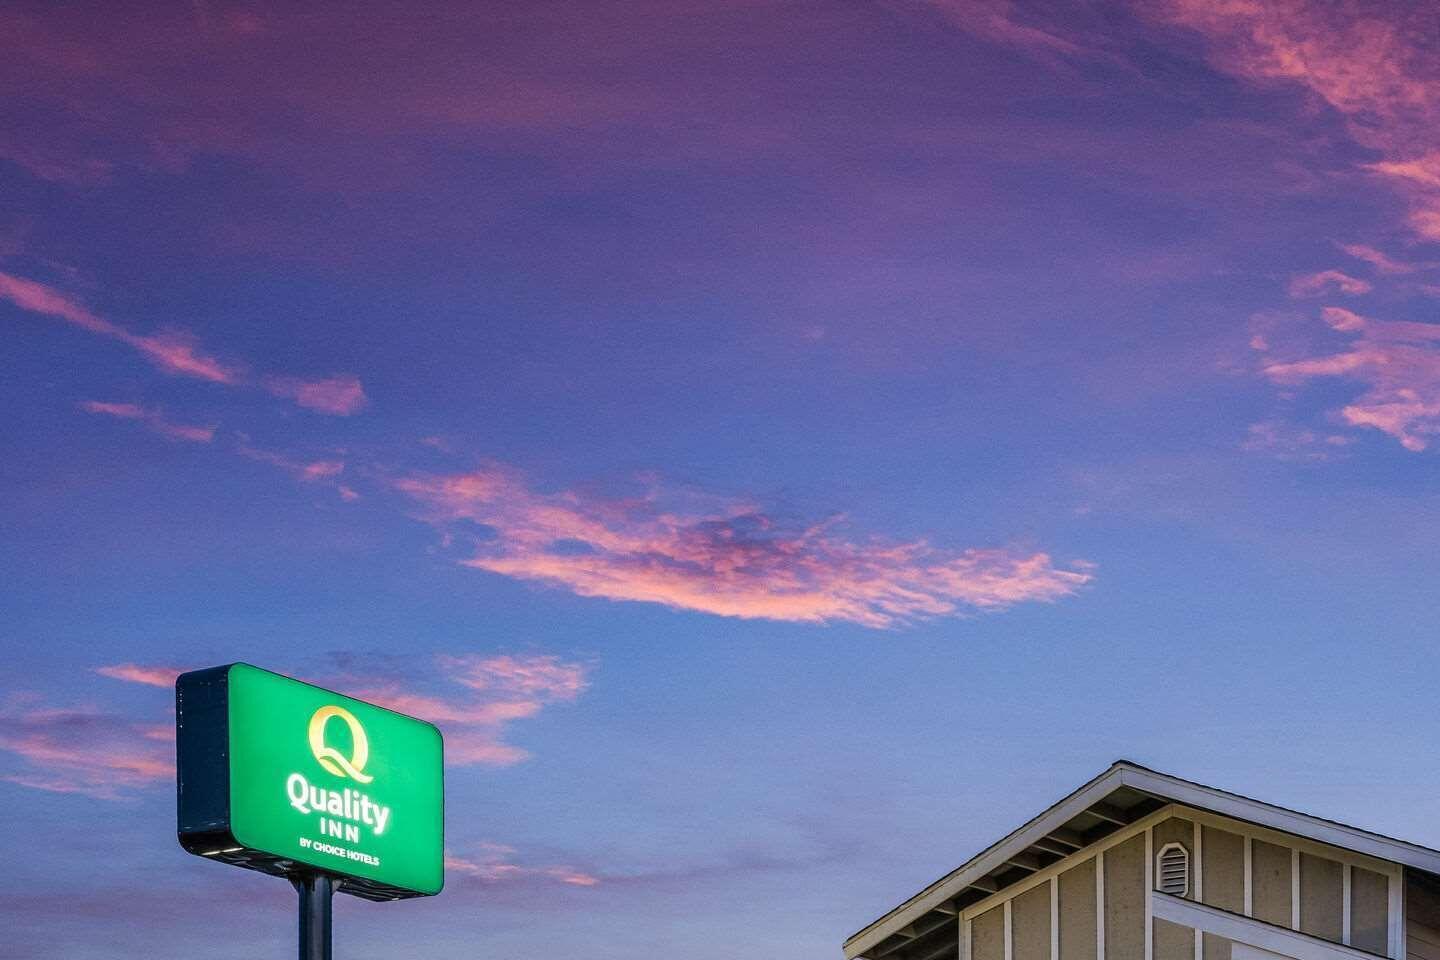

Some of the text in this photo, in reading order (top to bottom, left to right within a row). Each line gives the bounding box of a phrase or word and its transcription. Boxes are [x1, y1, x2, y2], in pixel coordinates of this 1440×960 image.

[308, 705, 374, 784] Q
[286, 773, 390, 835] Quality
[299, 837, 380, 866] BY CHOICE HOTELS
[319, 817, 360, 843] INN
